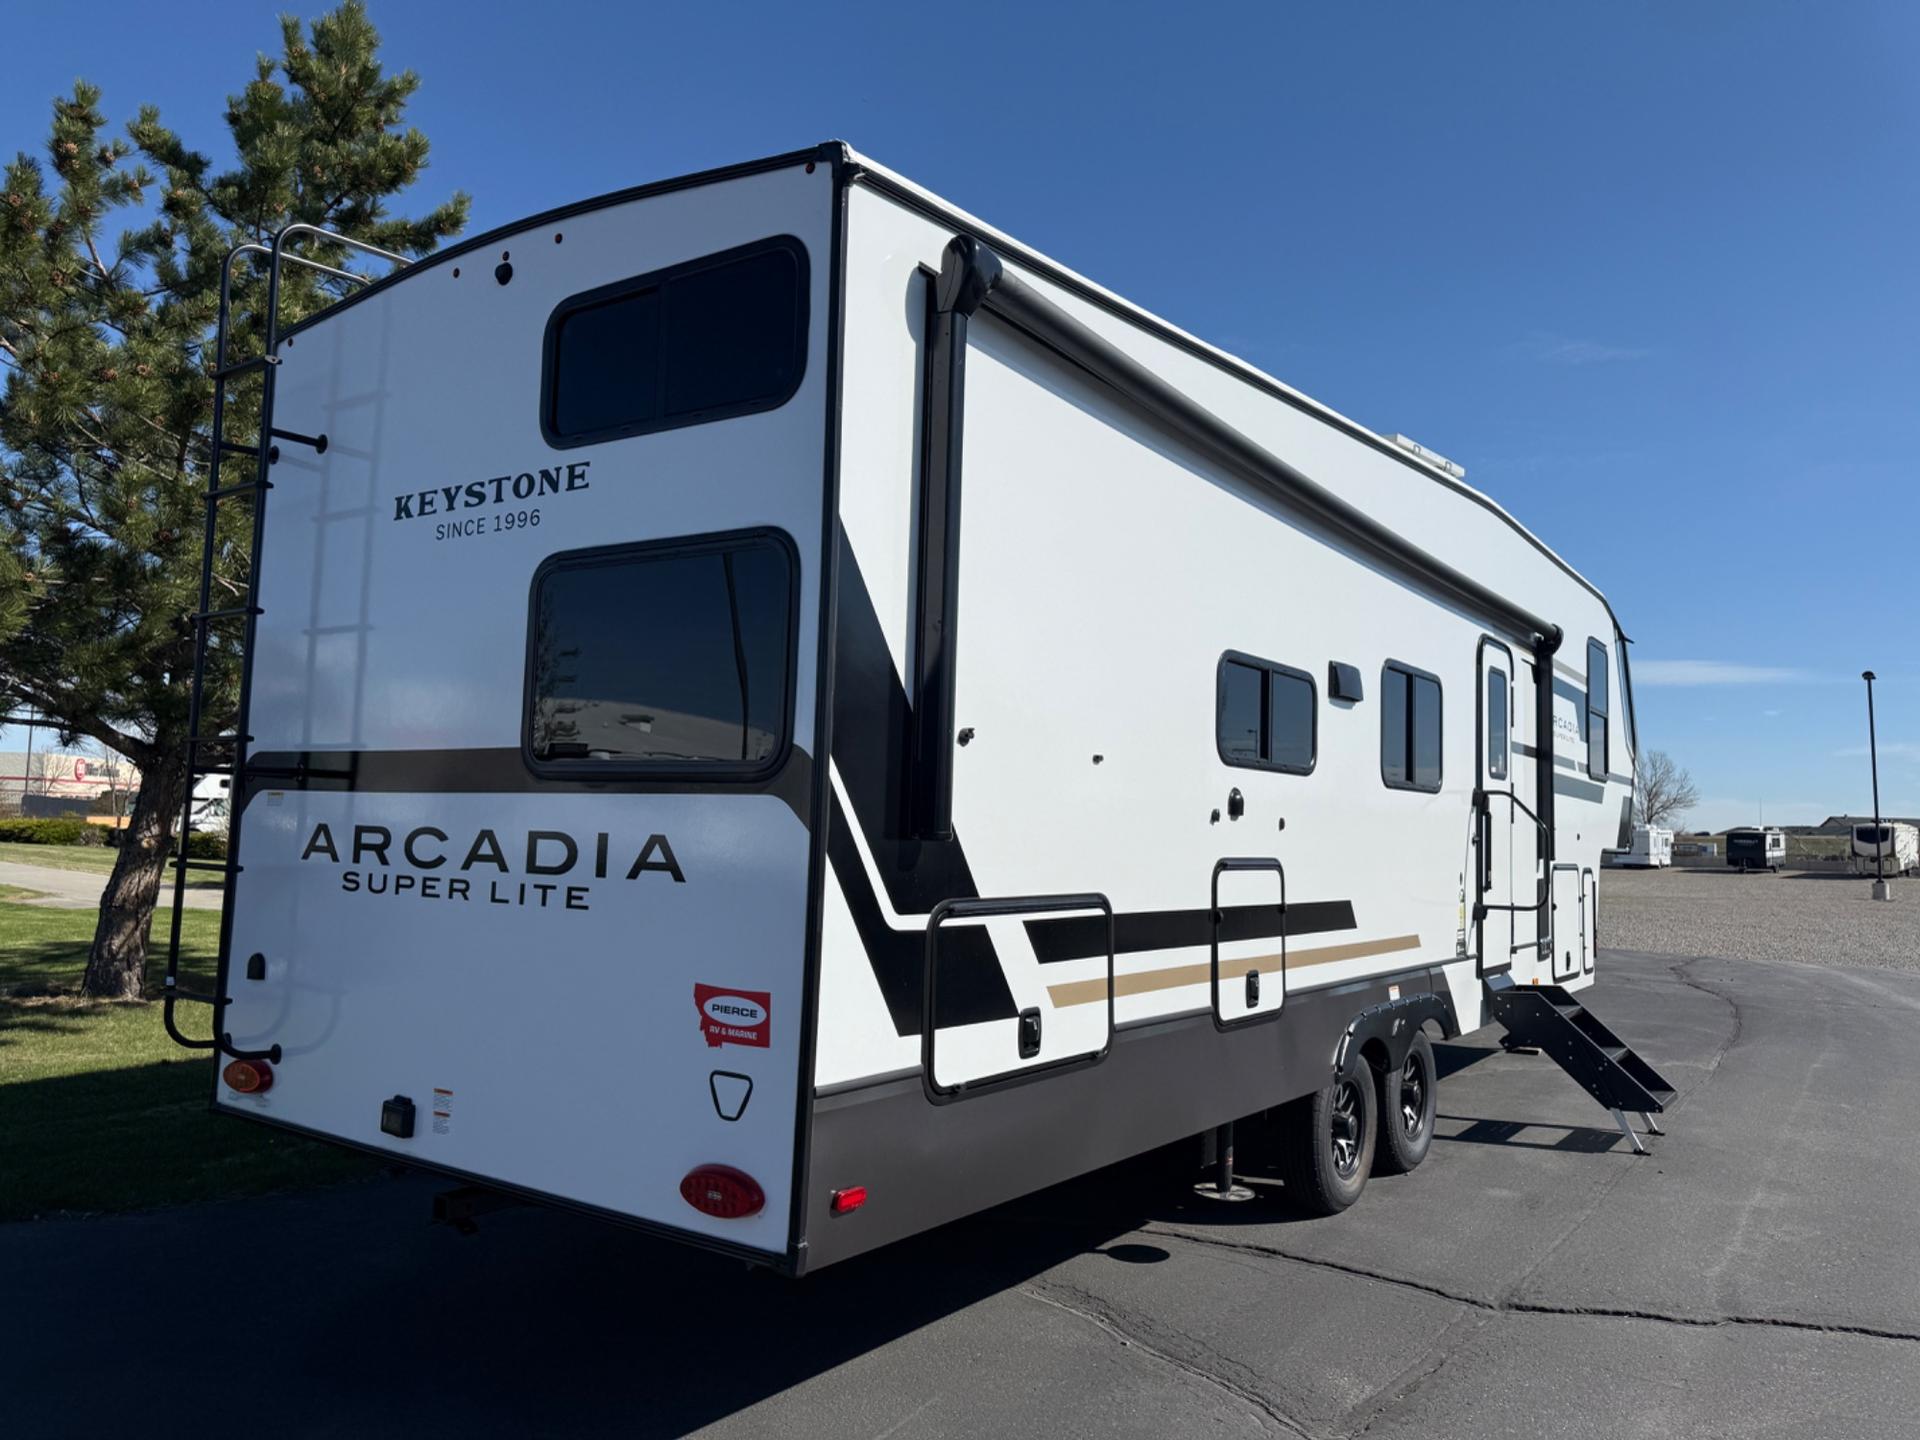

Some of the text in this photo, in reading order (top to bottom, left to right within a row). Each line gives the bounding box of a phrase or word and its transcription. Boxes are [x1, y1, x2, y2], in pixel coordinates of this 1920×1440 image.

[393, 461, 591, 521] KEYSTONE
[436, 508, 541, 541] SINCE 1996
[1553, 714, 1579, 734] RCADIA
[301, 823, 687, 883] ARCADIA
[342, 871, 590, 910] SUPER LITE
[712, 1003, 758, 1018] PIERCE
[709, 1025, 757, 1040] RV & MARINE
